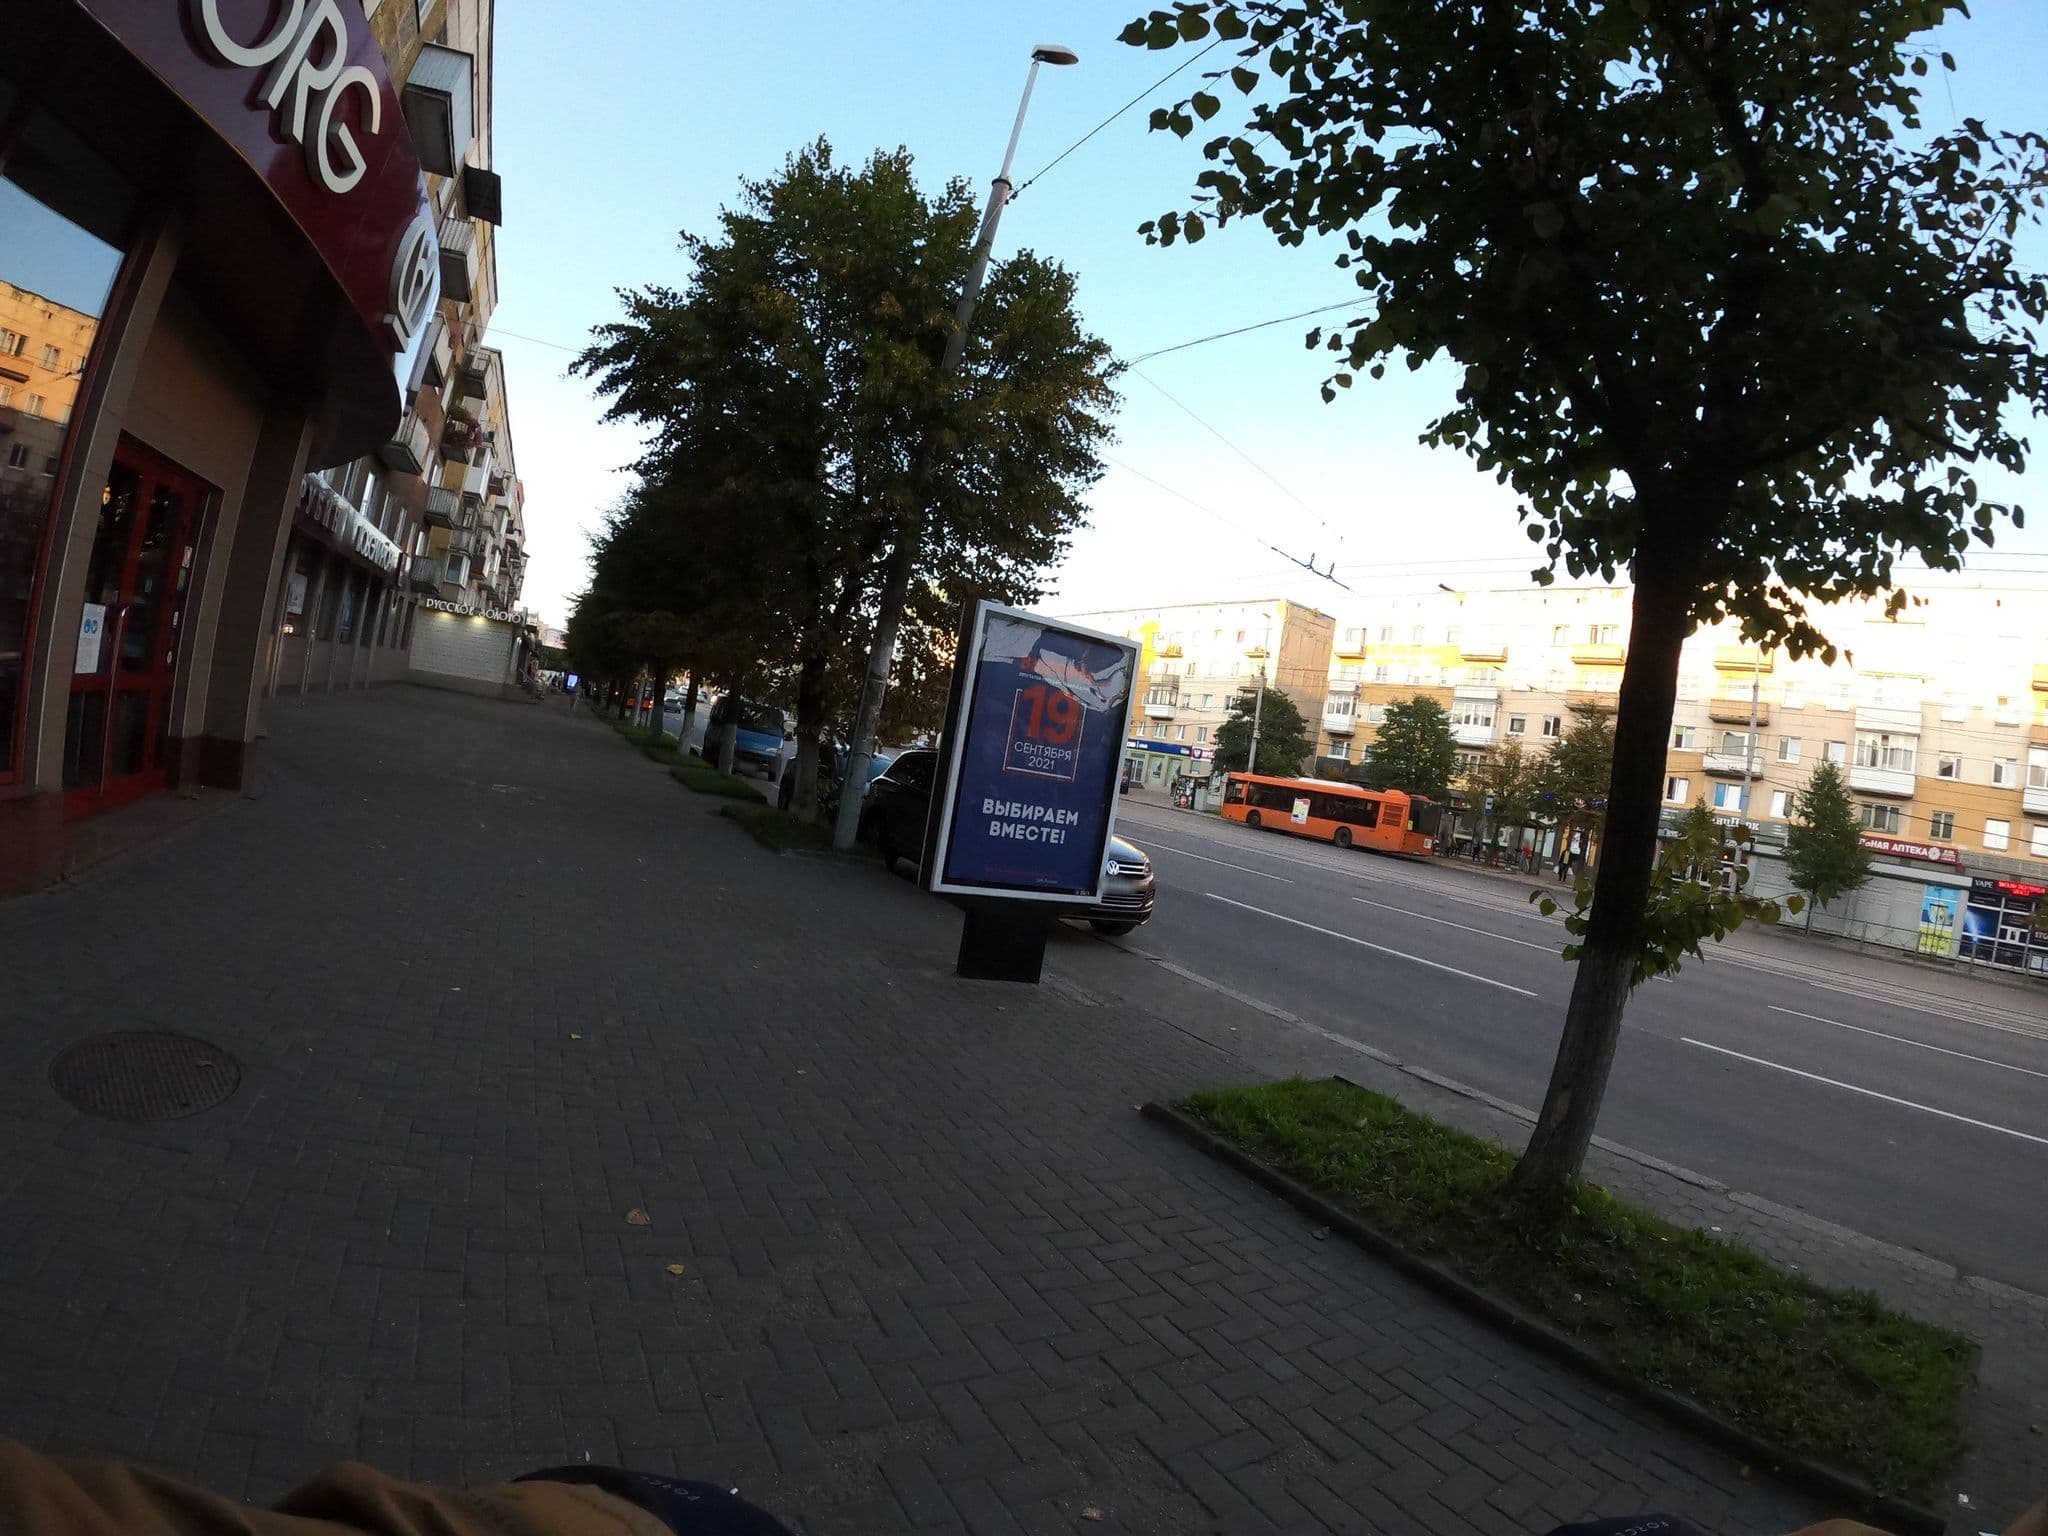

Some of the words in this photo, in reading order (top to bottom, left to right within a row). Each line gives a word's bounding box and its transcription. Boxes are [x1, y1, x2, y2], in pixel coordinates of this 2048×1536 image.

[426, 598, 474, 616] РУССКОЕ
[478, 608, 521, 623] ЗОЛОТО
[1023, 684, 1080, 745] 19
[1014, 741, 1072, 761] СЕНТЯБРЯ
[1028, 755, 1055, 770] 2021
[982, 798, 1079, 826] ВЫБИРАЕМ
[989, 820, 1066, 844] ВМЕСТЕ!
[1892, 843, 1928, 856] АПТЕКА
[1974, 879, 1994, 889] VAPE
